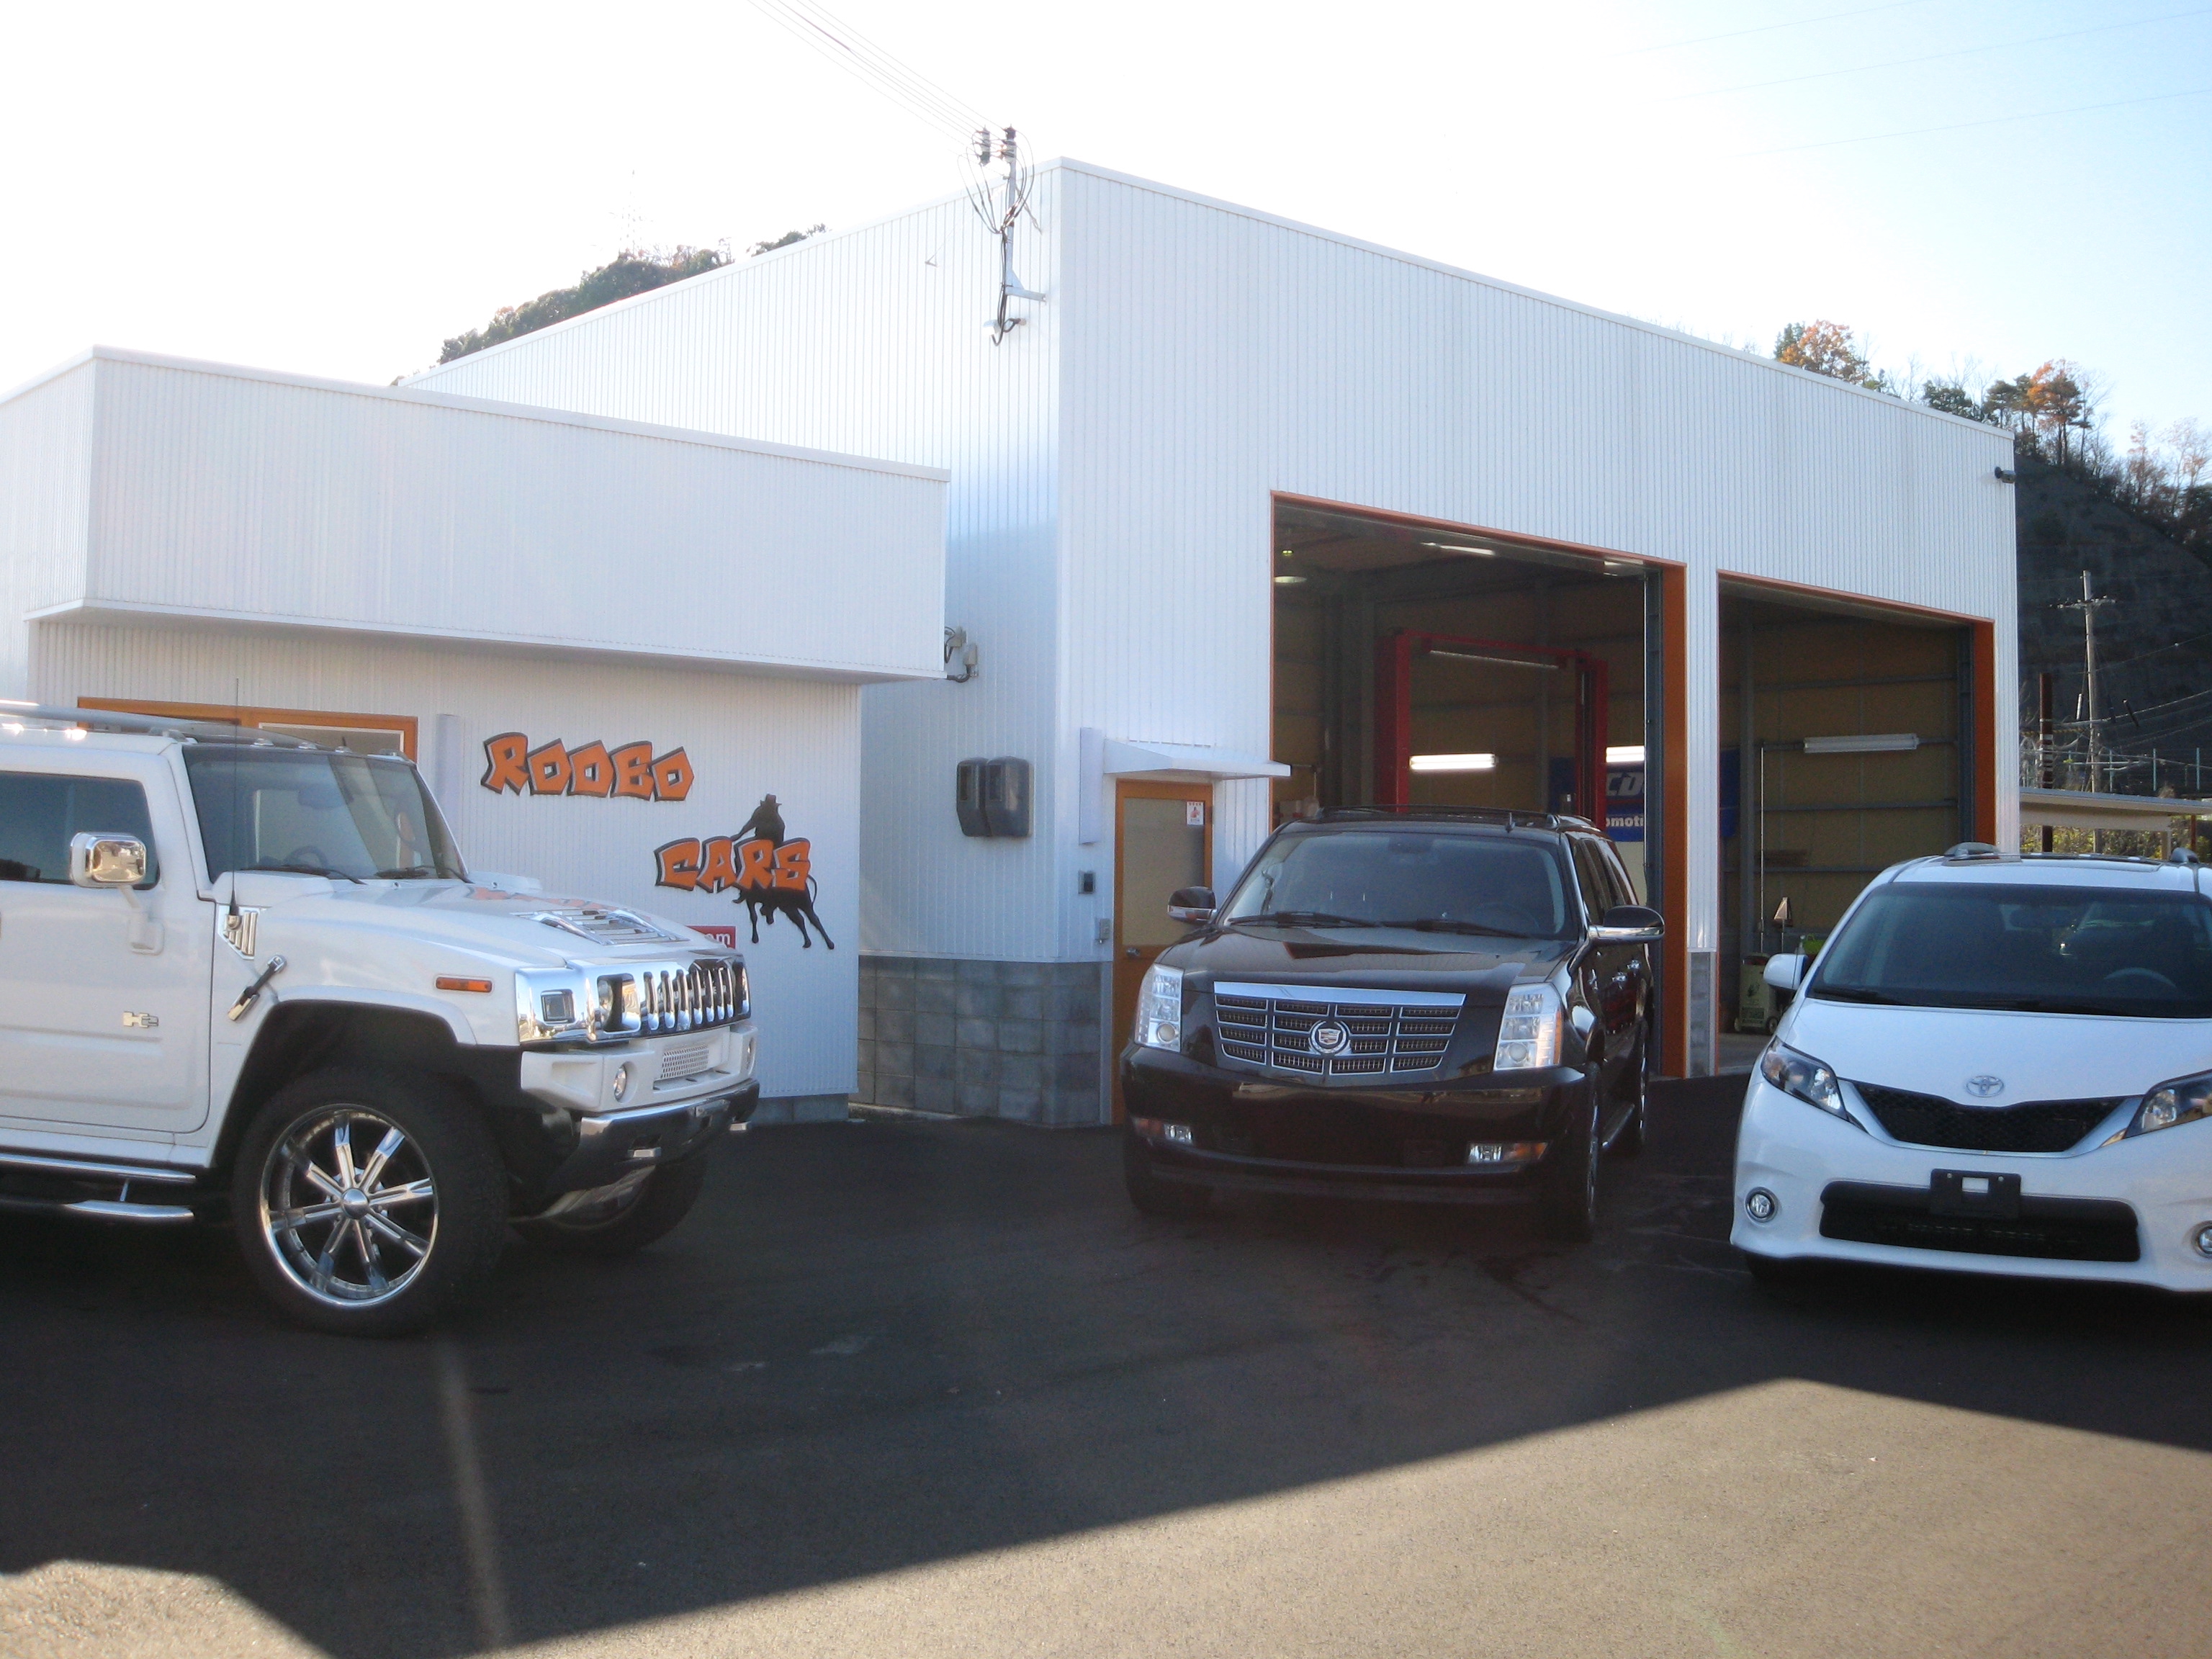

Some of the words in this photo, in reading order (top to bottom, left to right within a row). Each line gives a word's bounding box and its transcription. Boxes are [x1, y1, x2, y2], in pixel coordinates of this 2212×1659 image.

[480, 732, 694, 801] RODEO
[654, 836, 811, 893] CARS
[123, 1011, 159, 1028] H2
